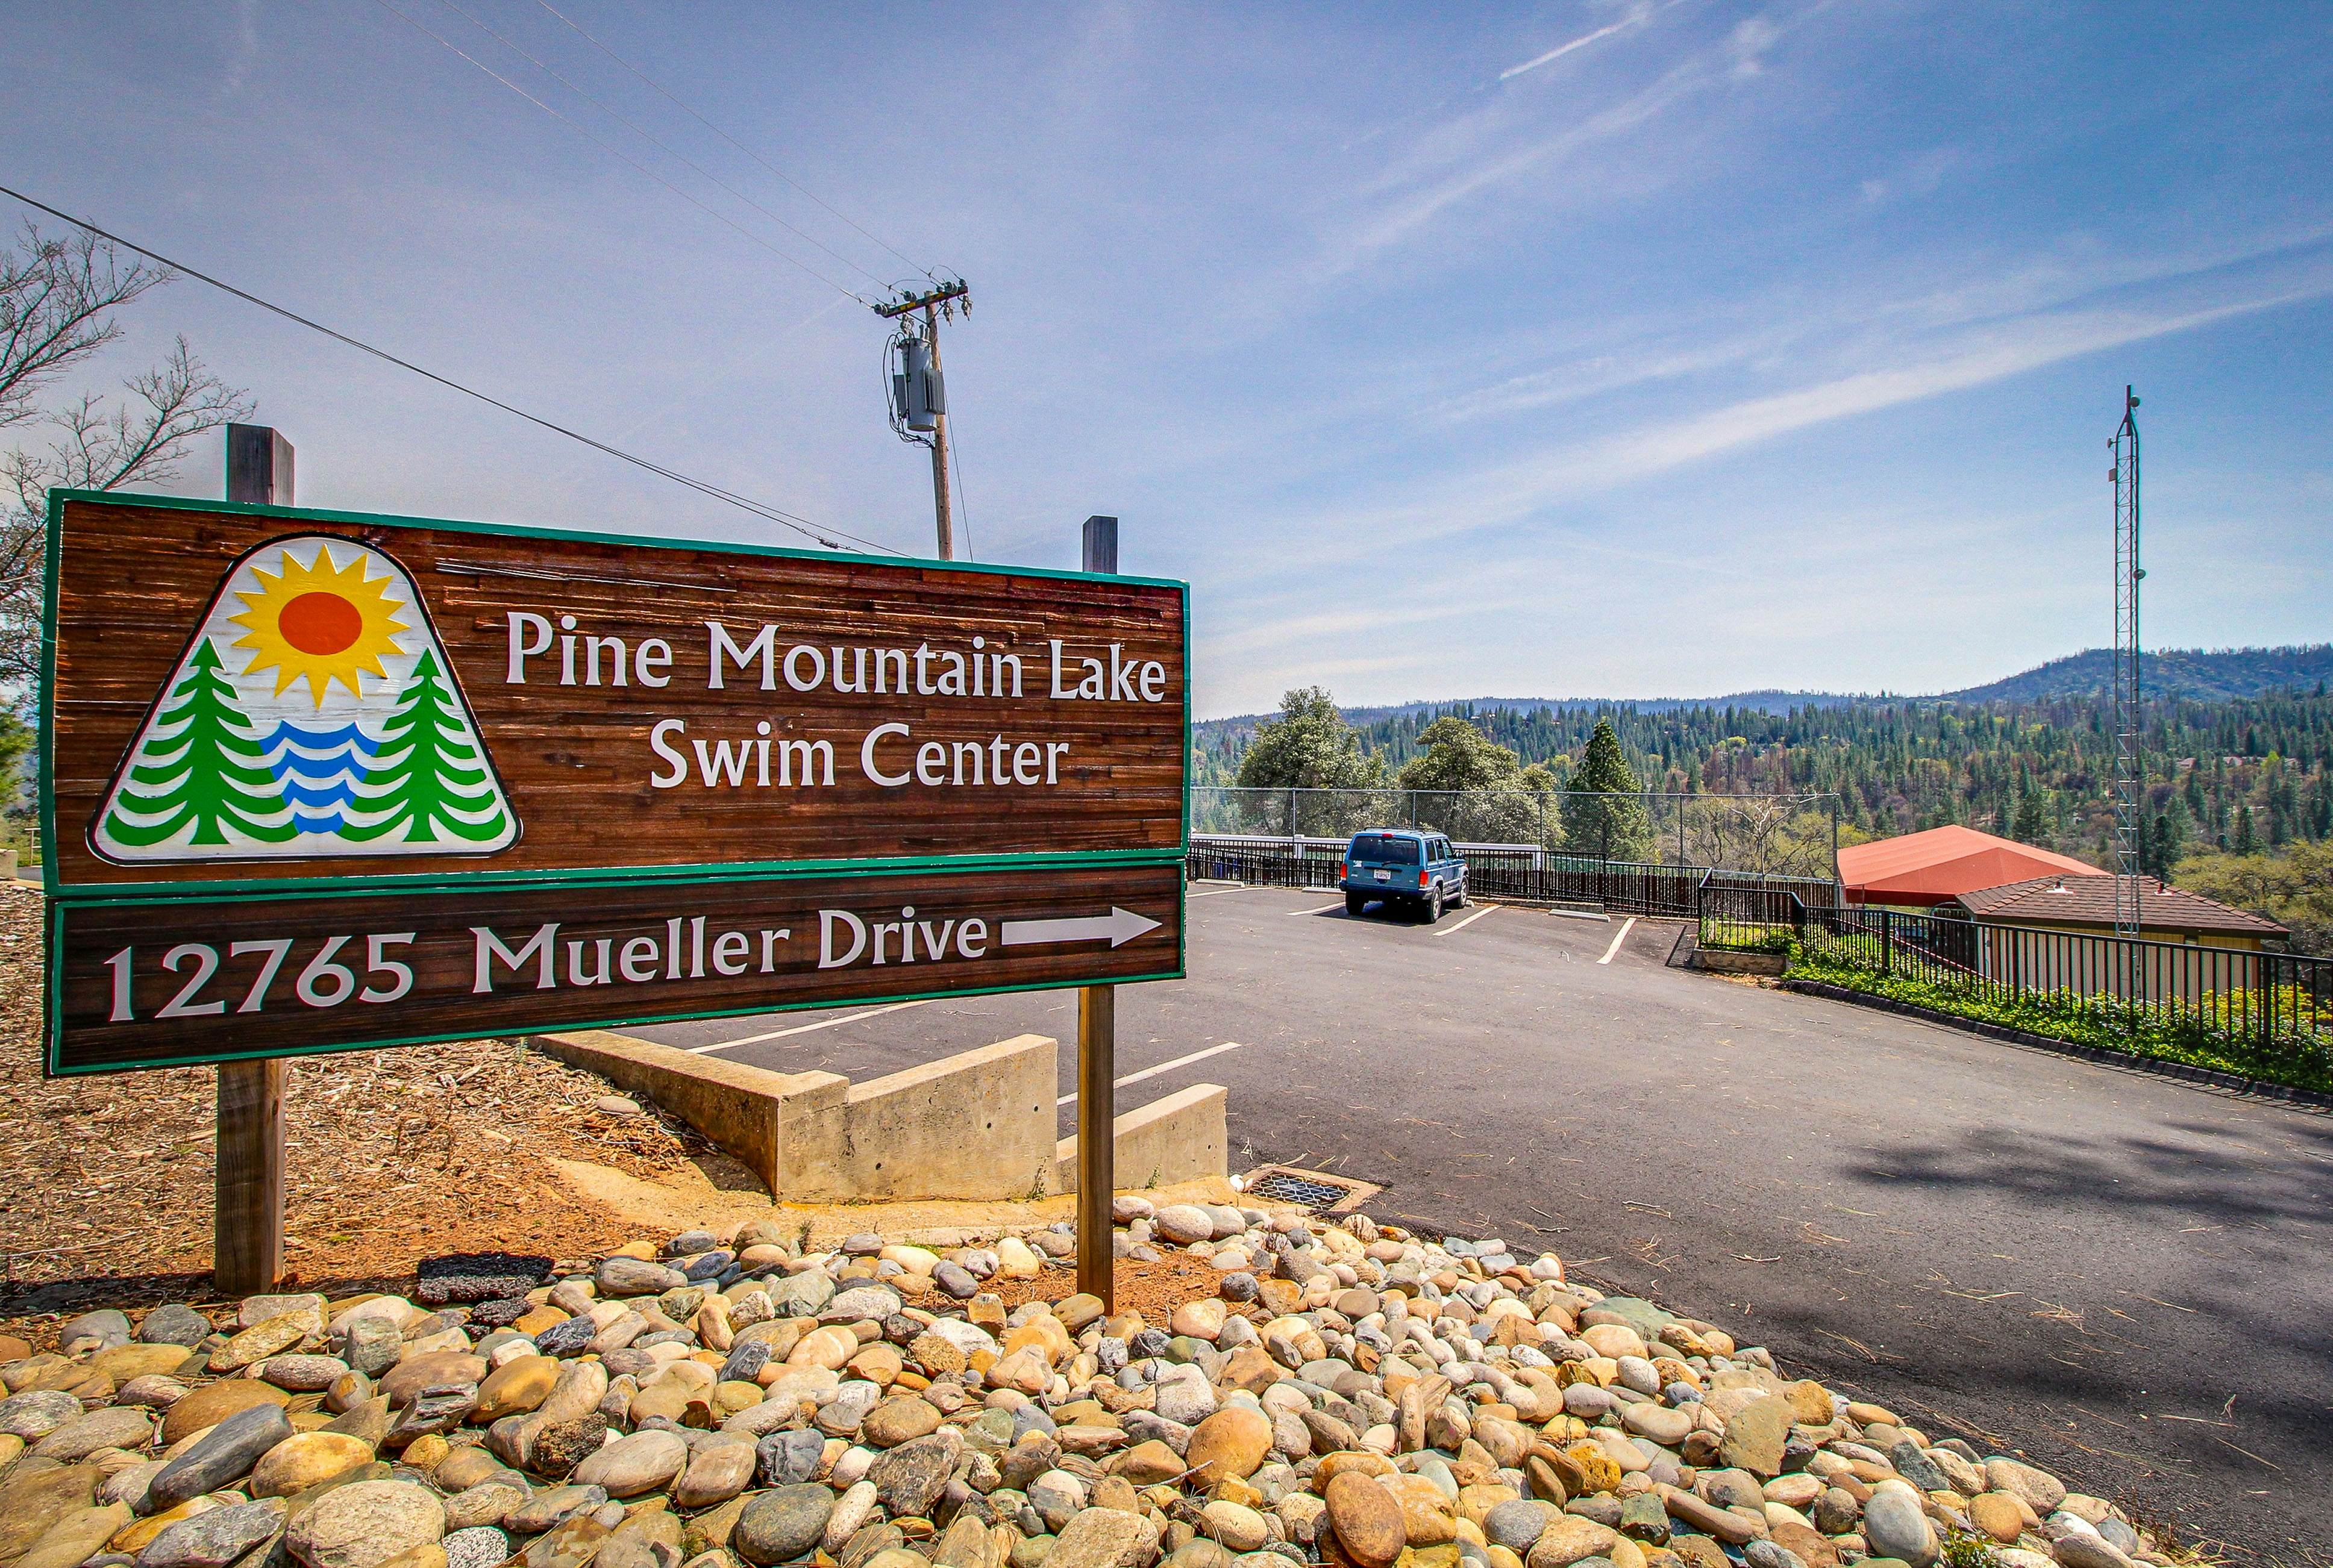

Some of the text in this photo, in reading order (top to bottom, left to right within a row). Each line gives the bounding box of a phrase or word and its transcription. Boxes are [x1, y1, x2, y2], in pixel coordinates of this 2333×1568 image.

[505, 611, 1166, 702] Pine Mountain Lake
[650, 719, 1070, 789] Swim Center
[104, 906, 988, 1023] 12765 Mueller Drive
